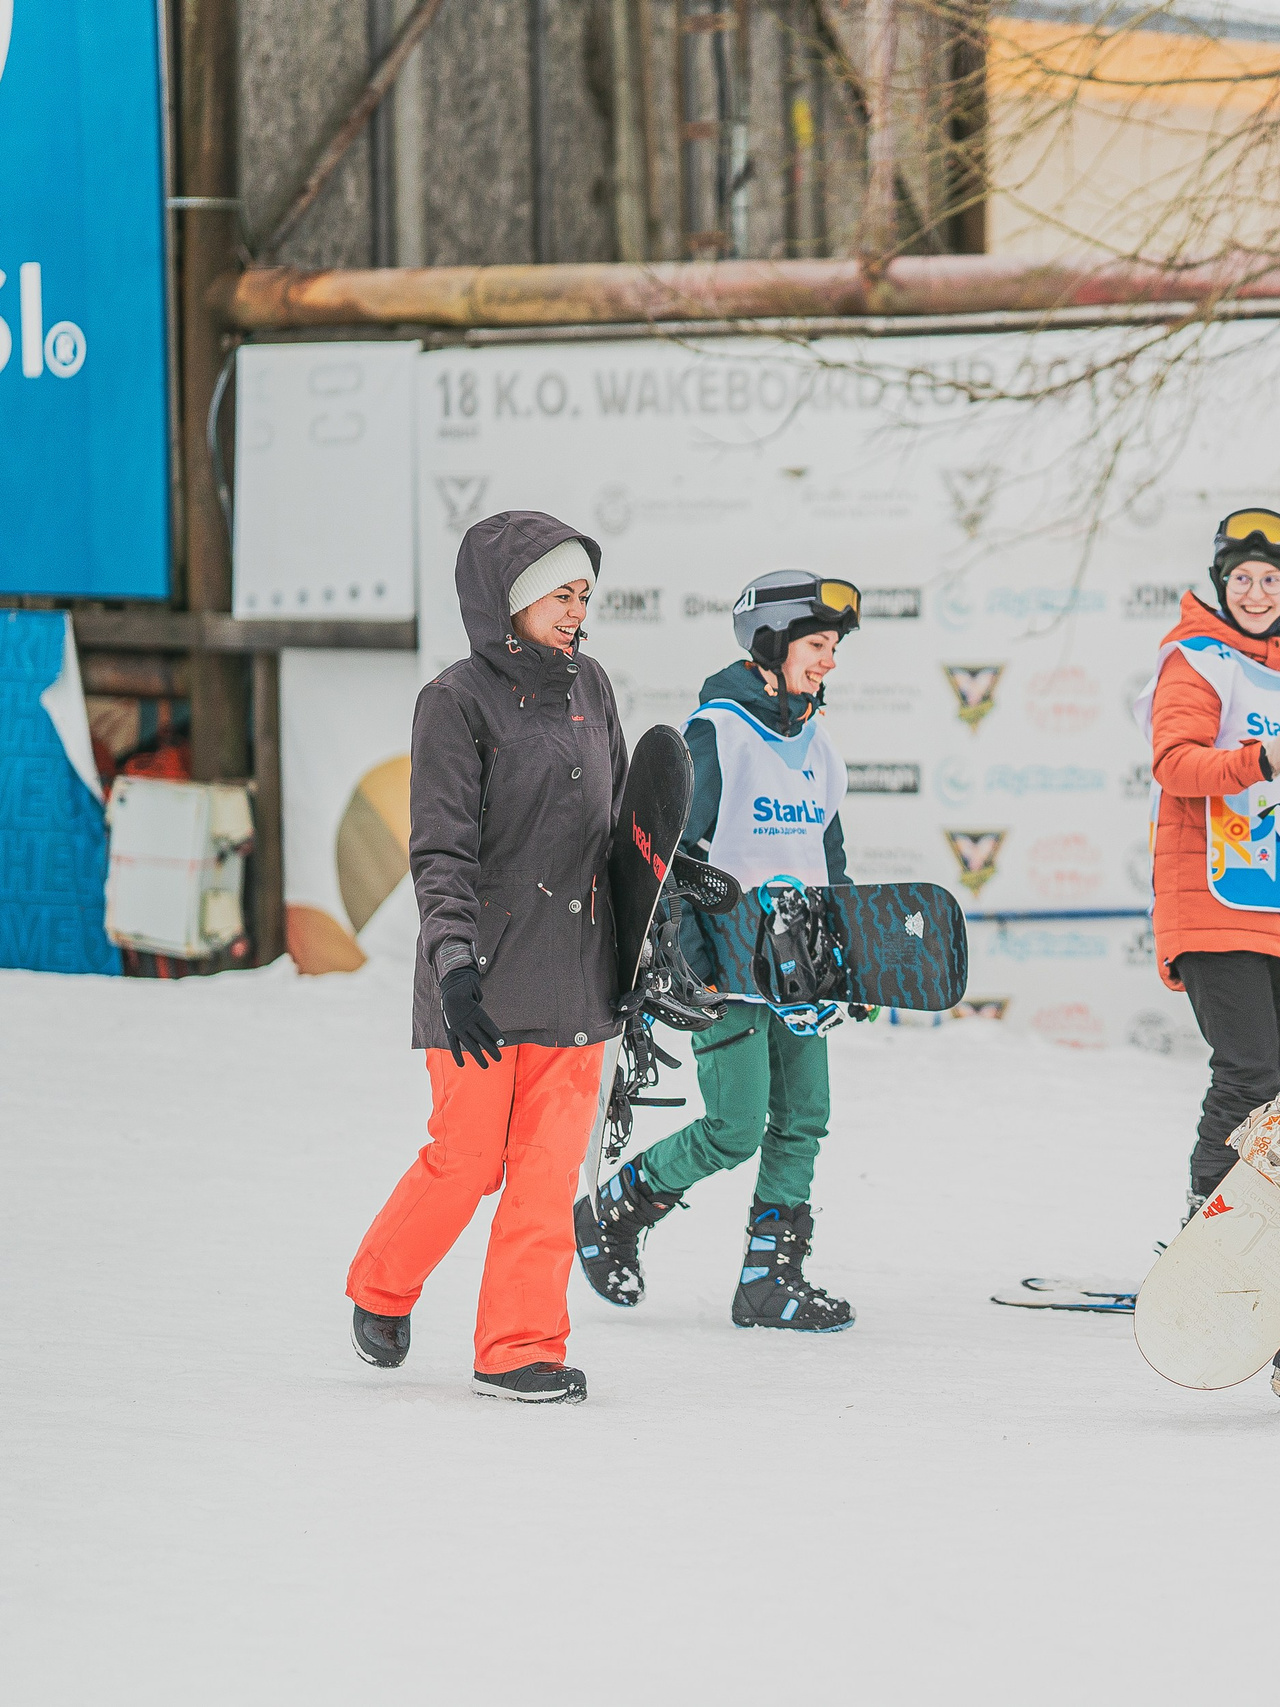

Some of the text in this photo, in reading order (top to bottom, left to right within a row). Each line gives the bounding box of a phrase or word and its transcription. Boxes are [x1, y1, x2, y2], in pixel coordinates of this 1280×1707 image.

[437, 370, 479, 417] 18
[494, 368, 582, 418] K.O.
[753, 796, 825, 825] StarLin
[632, 810, 651, 865] head
[1256, 1136, 1272, 1157] 390
